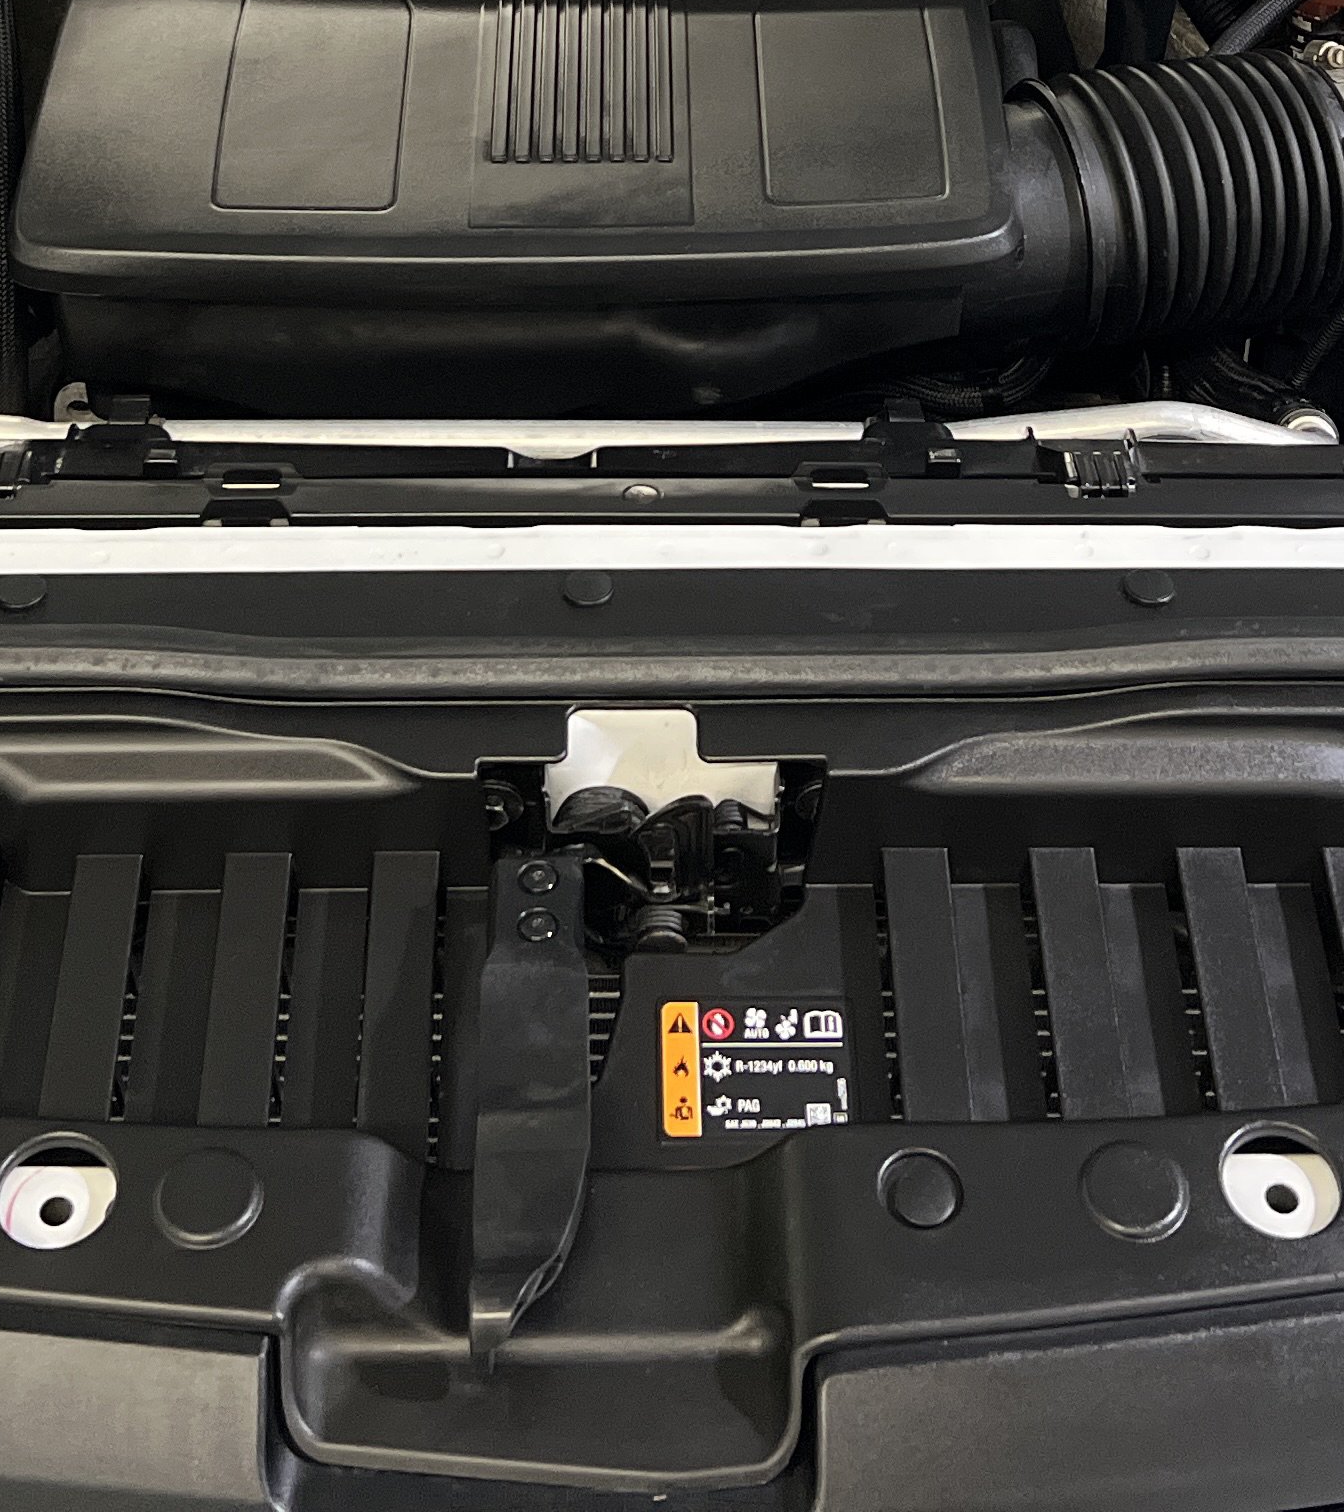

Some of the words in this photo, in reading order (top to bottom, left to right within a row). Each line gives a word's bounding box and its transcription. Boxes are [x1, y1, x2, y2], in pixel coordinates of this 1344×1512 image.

[744, 1027, 770, 1039] AUTO
[735, 1059, 783, 1074] R-1234yf
[819, 1059, 834, 1074] kg
[737, 1098, 761, 1113] PAG
